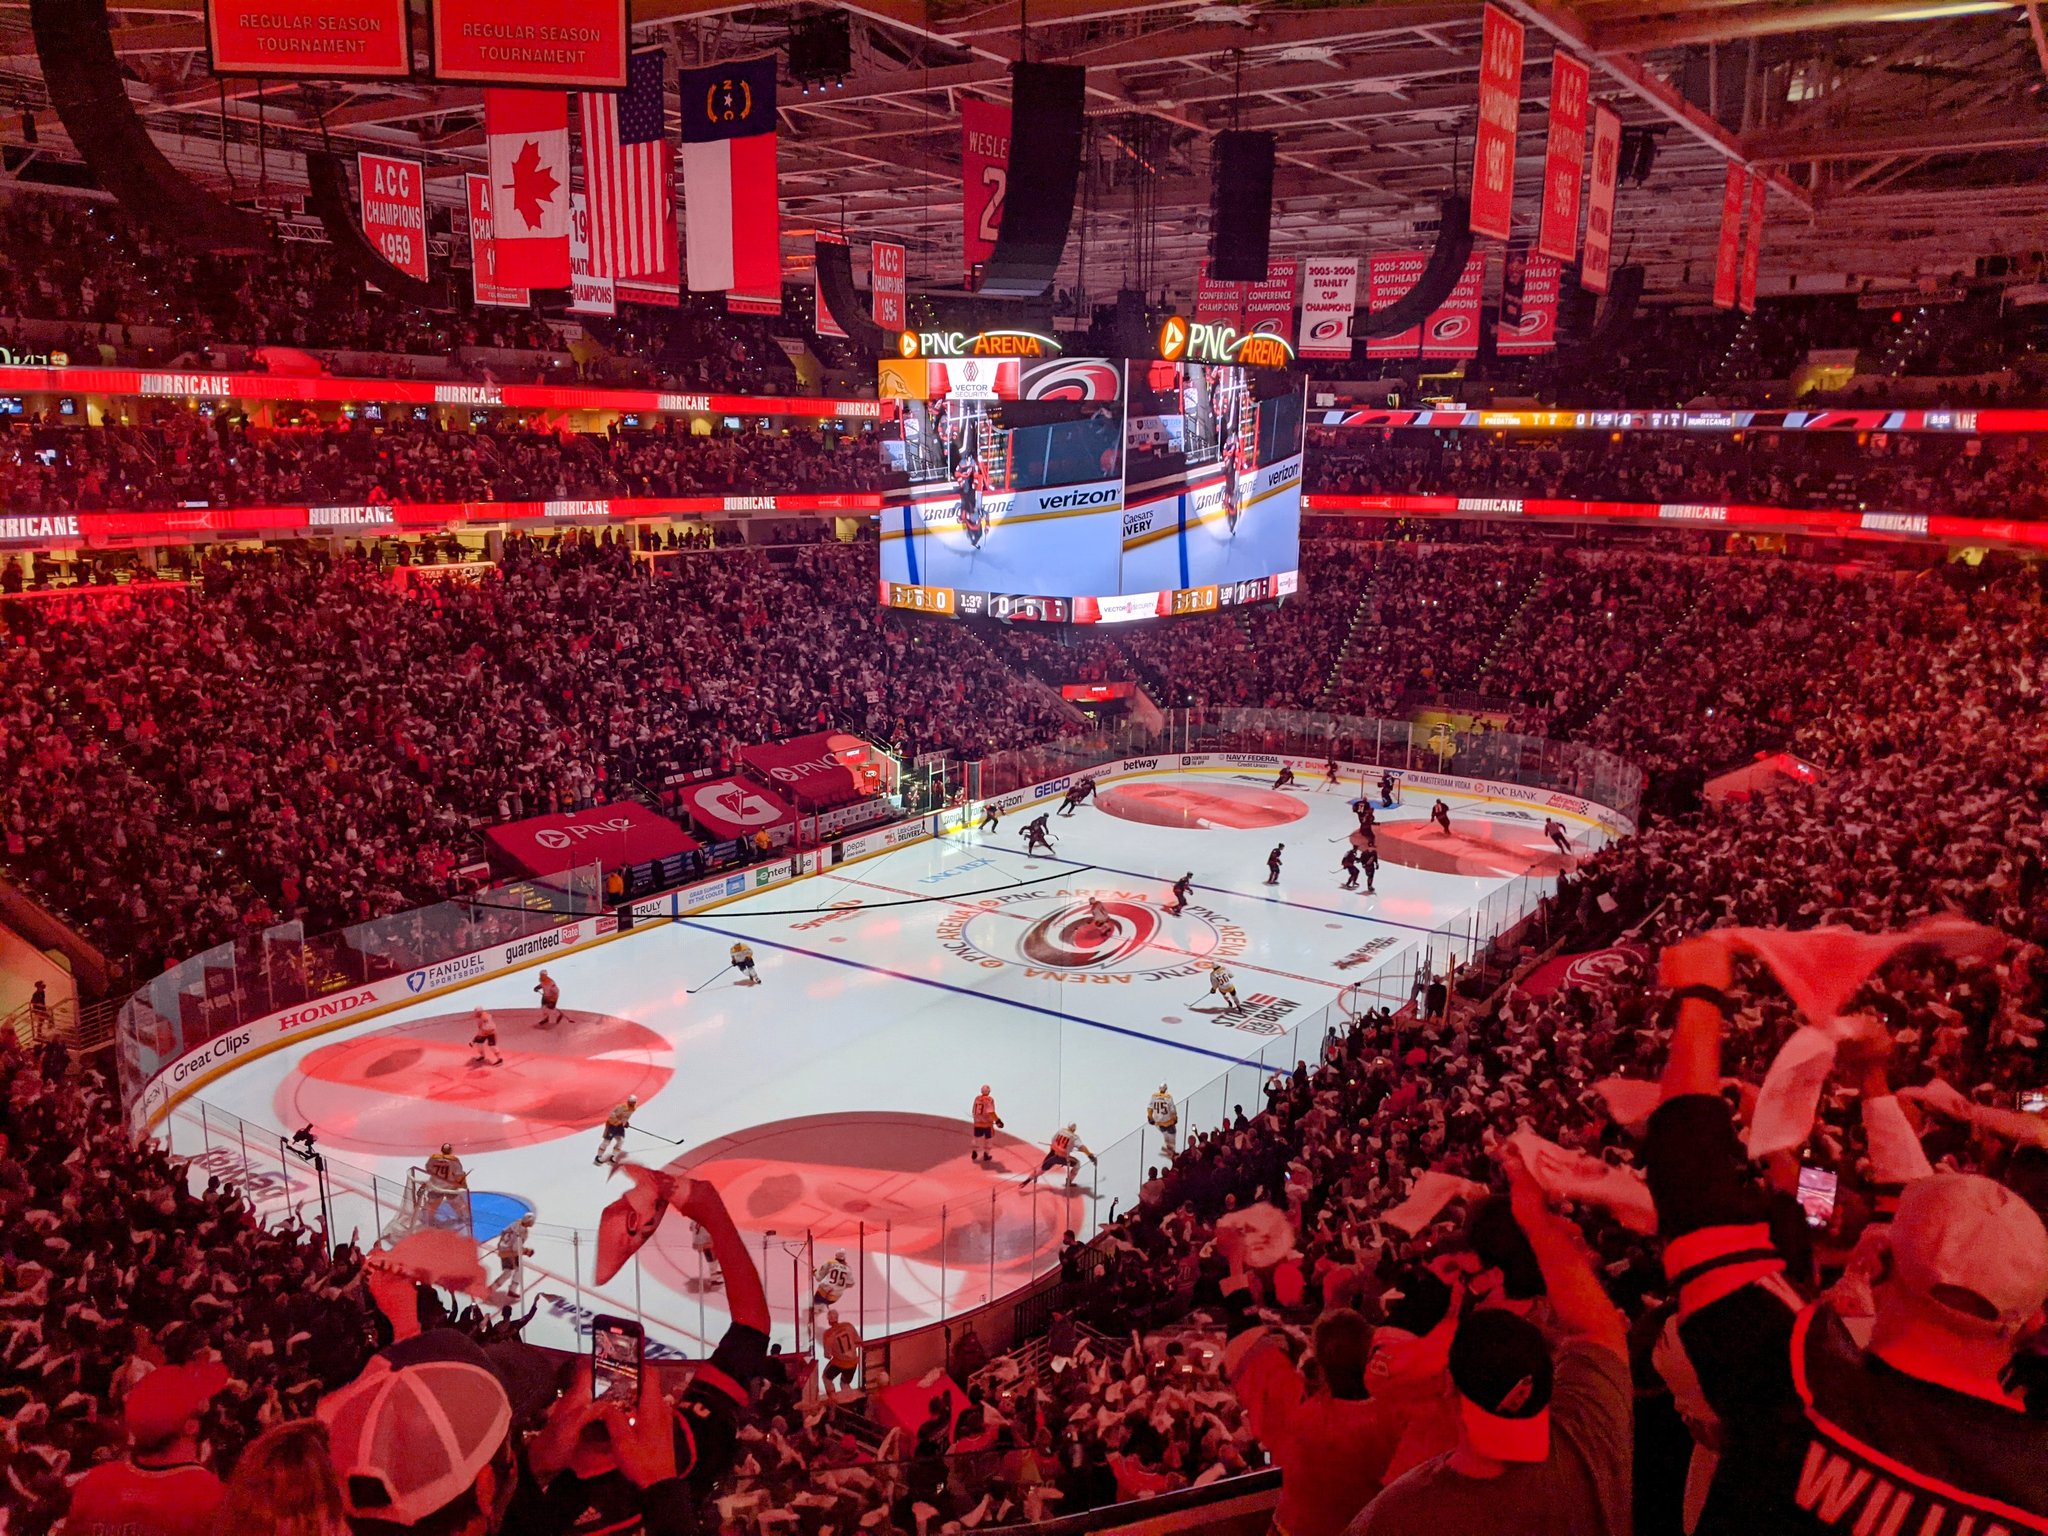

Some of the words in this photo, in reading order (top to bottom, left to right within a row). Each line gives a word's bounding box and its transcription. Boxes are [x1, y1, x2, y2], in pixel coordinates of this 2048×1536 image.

[240, 14, 312, 30] REGULAR
[318, 17, 381, 32] SEASON
[463, 22, 534, 39] REGULAR
[540, 27, 600, 42] SEASON
[257, 37, 366, 53] TOURNAMENT
[479, 46, 586, 64] TOURNAMENT
[969, 130, 1009, 159] WESLE
[375, 164, 409, 197] ACC
[978, 166, 1007, 241] 2
[367, 201, 421, 229] CHAMPIONS
[379, 234, 411, 265] 1959
[879, 248, 898, 272] ACC
[1374, 262, 1423, 272] 2005-2006
[1308, 267, 1356, 276] 2005-2006
[1373, 273, 1423, 284] SOUTHEAST
[1254, 279, 1287, 288] EASTERN
[1313, 278, 1349, 288] STANLEY
[1377, 287, 1411, 296] DIVISIO
[572, 283, 612, 304] HAMPIONS
[1199, 291, 1239, 300] CONFERENCE
[1248, 291, 1291, 300] CONFERENCE
[1321, 291, 1338, 300] CUP
[1198, 303, 1239, 312] CHAMPIONS
[1247, 303, 1291, 312] CHAMPIONS
[1305, 303, 1352, 312] CHAMPIONS
[919, 332, 964, 355] PNC
[974, 333, 1041, 354] ARENA
[1188, 323, 1236, 361] PNC
[1238, 332, 1286, 366] ARENA
[140, 375, 230, 395] HURRICANE
[658, 394, 710, 411] HURRICANE
[835, 401, 879, 416] HURRICA
[1484, 417, 1521, 425] PREDATORS
[1576, 414, 1585, 425] 0
[1623, 413, 1630, 425] 0
[1688, 418, 1732, 426] HURRICANES
[1268, 463, 1298, 486] verizon
[724, 497, 776, 510] HURRICANE
[1040, 489, 1117, 509] verizon
[1458, 499, 1523, 512] HURRICANE
[309, 506, 394, 525] HURRICANE
[544, 500, 609, 516] HURRICANE
[1659, 504, 1727, 520] HURRICANE
[1123, 510, 1154, 525] Caesars
[1861, 512, 1928, 532] HURRICANE
[1206, 590, 1212, 606] 0
[1240, 584, 1246, 600] 0
[936, 592, 946, 609] 0
[960, 594, 982, 609] 1:37
[999, 597, 1008, 614] 0
[1026, 605, 1033, 617] 0
[1055, 608, 1061, 617] 1
[795, 753, 840, 776] PNC
[1123, 759, 1158, 771] betway
[1247, 755, 1279, 763] FEDERAL
[1034, 777, 1070, 798] GEICO
[1408, 774, 1419, 782] NEW
[1420, 776, 1453, 787] AMSTERDAM
[1454, 780, 1471, 789] VODKA
[1487, 785, 1509, 797] PNC
[1510, 789, 1537, 800] BANK
[1551, 794, 1580, 806] Advance
[564, 818, 636, 839] PNC
[898, 829, 920, 842] DELIVERY
[846, 839, 865, 856] pepsi
[689, 889, 703, 898] GRAB
[703, 883, 724, 895] SUMMER
[696, 893, 707, 903] THE
[707, 889, 724, 900] COOLER
[997, 891, 1049, 903] PNC
[1056, 889, 1147, 901] ARENA
[634, 900, 662, 916] TRULY
[936, 910, 973, 941] ARENA
[1185, 906, 1230, 923] PNC
[1212, 925, 1247, 957] ARENA
[506, 930, 560, 964] guaranteed
[562, 927, 579, 940] Rate
[943, 942, 981, 962] PNC
[429, 954, 484, 979] FANDUEL
[1138, 966, 1202, 982] PNC
[430, 965, 485, 987] SPORTSBOOK
[1024, 968, 1133, 984] ARENA
[279, 990, 378, 1032] HONDA
[1254, 999, 1302, 1023] BREW
[173, 1052, 211, 1082] Great
[214, 1032, 250, 1058] Clips
[1153, 1101, 1169, 1115] 45
[433, 1165, 449, 1179] 74
[829, 1269, 848, 1287] 95
[836, 1333, 851, 1354] 17
